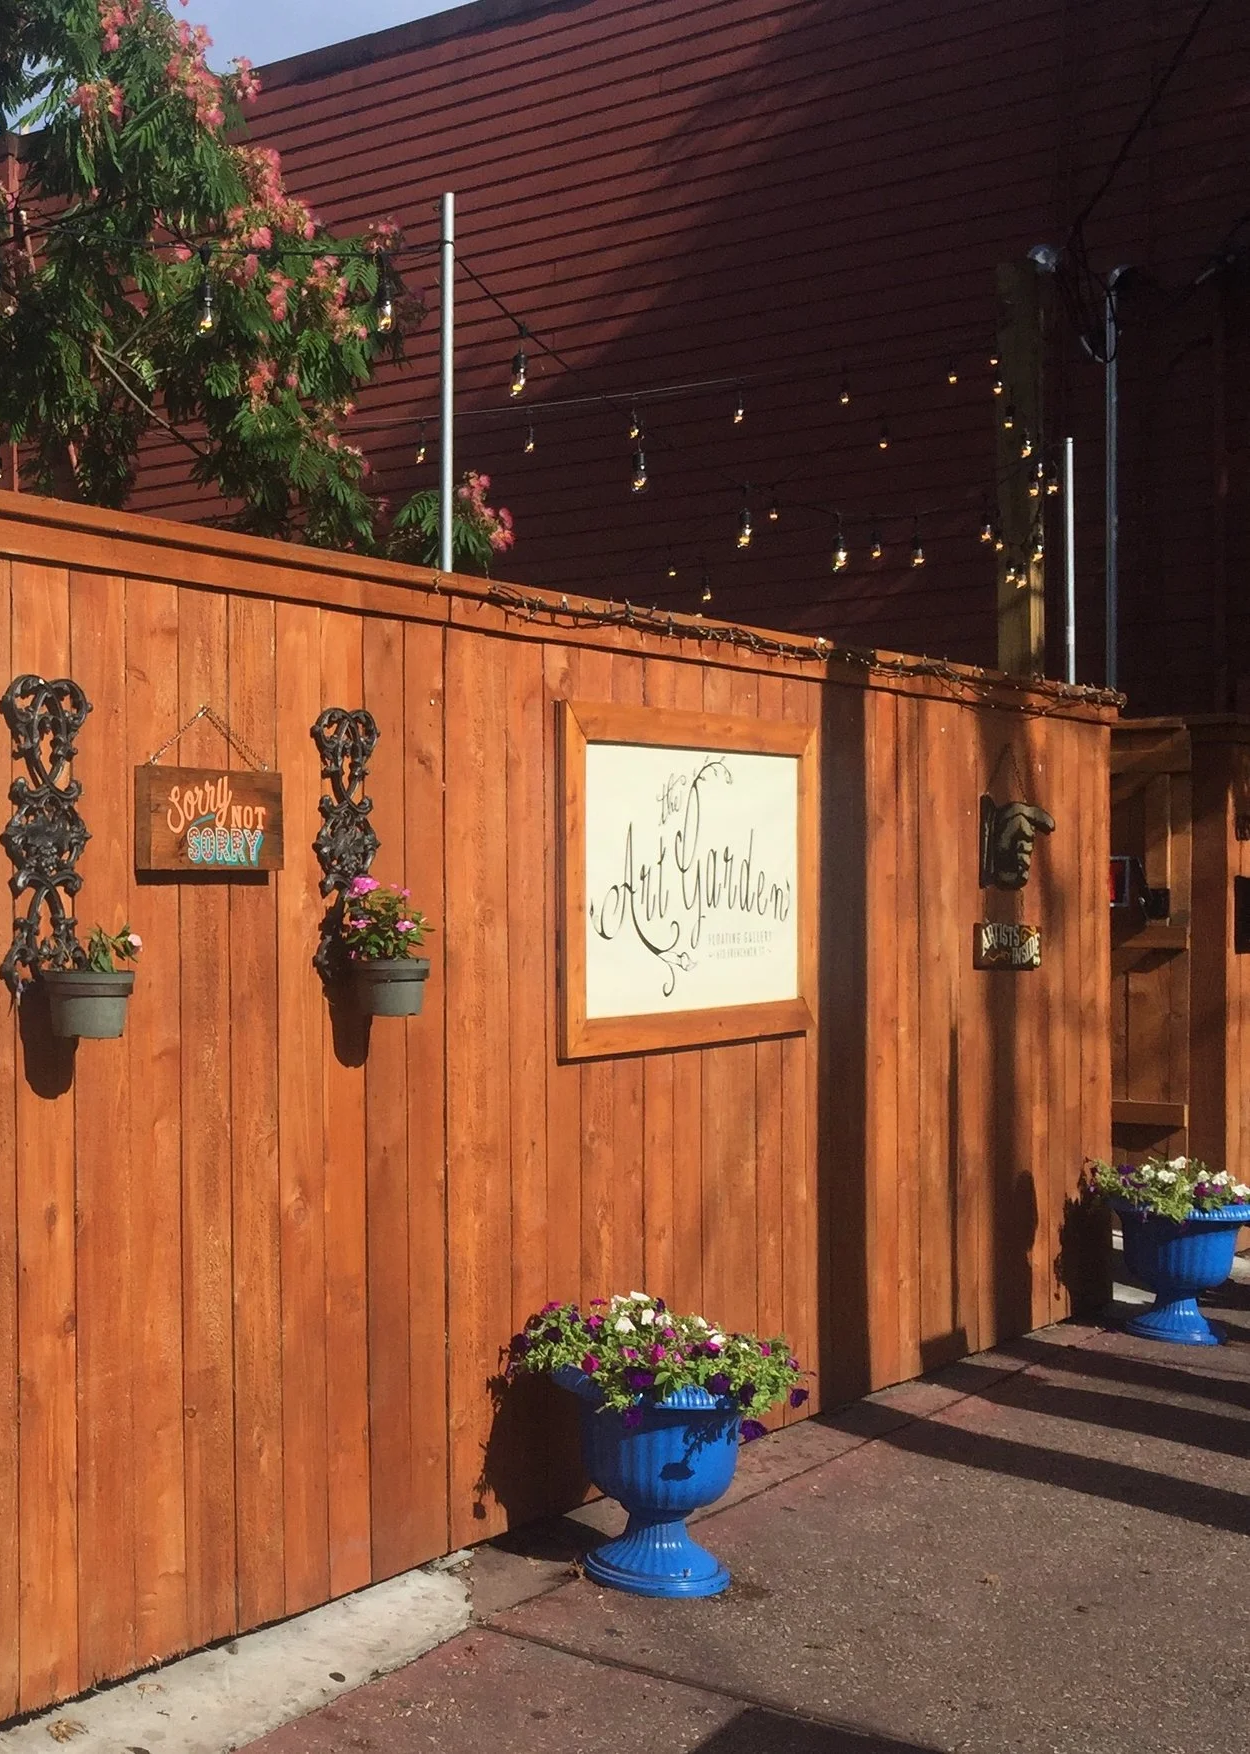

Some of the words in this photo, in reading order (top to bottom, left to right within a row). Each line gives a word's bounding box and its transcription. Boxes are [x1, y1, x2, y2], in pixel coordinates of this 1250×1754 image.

[167, 776, 233, 833] Sorry
[230, 805, 267, 830] NOT
[656, 773, 686, 826] the
[187, 826, 264, 867] SORRY
[590, 821, 670, 953] Art
[674, 780, 790, 950] Garden
[981, 922, 1020, 958] ARTISTS
